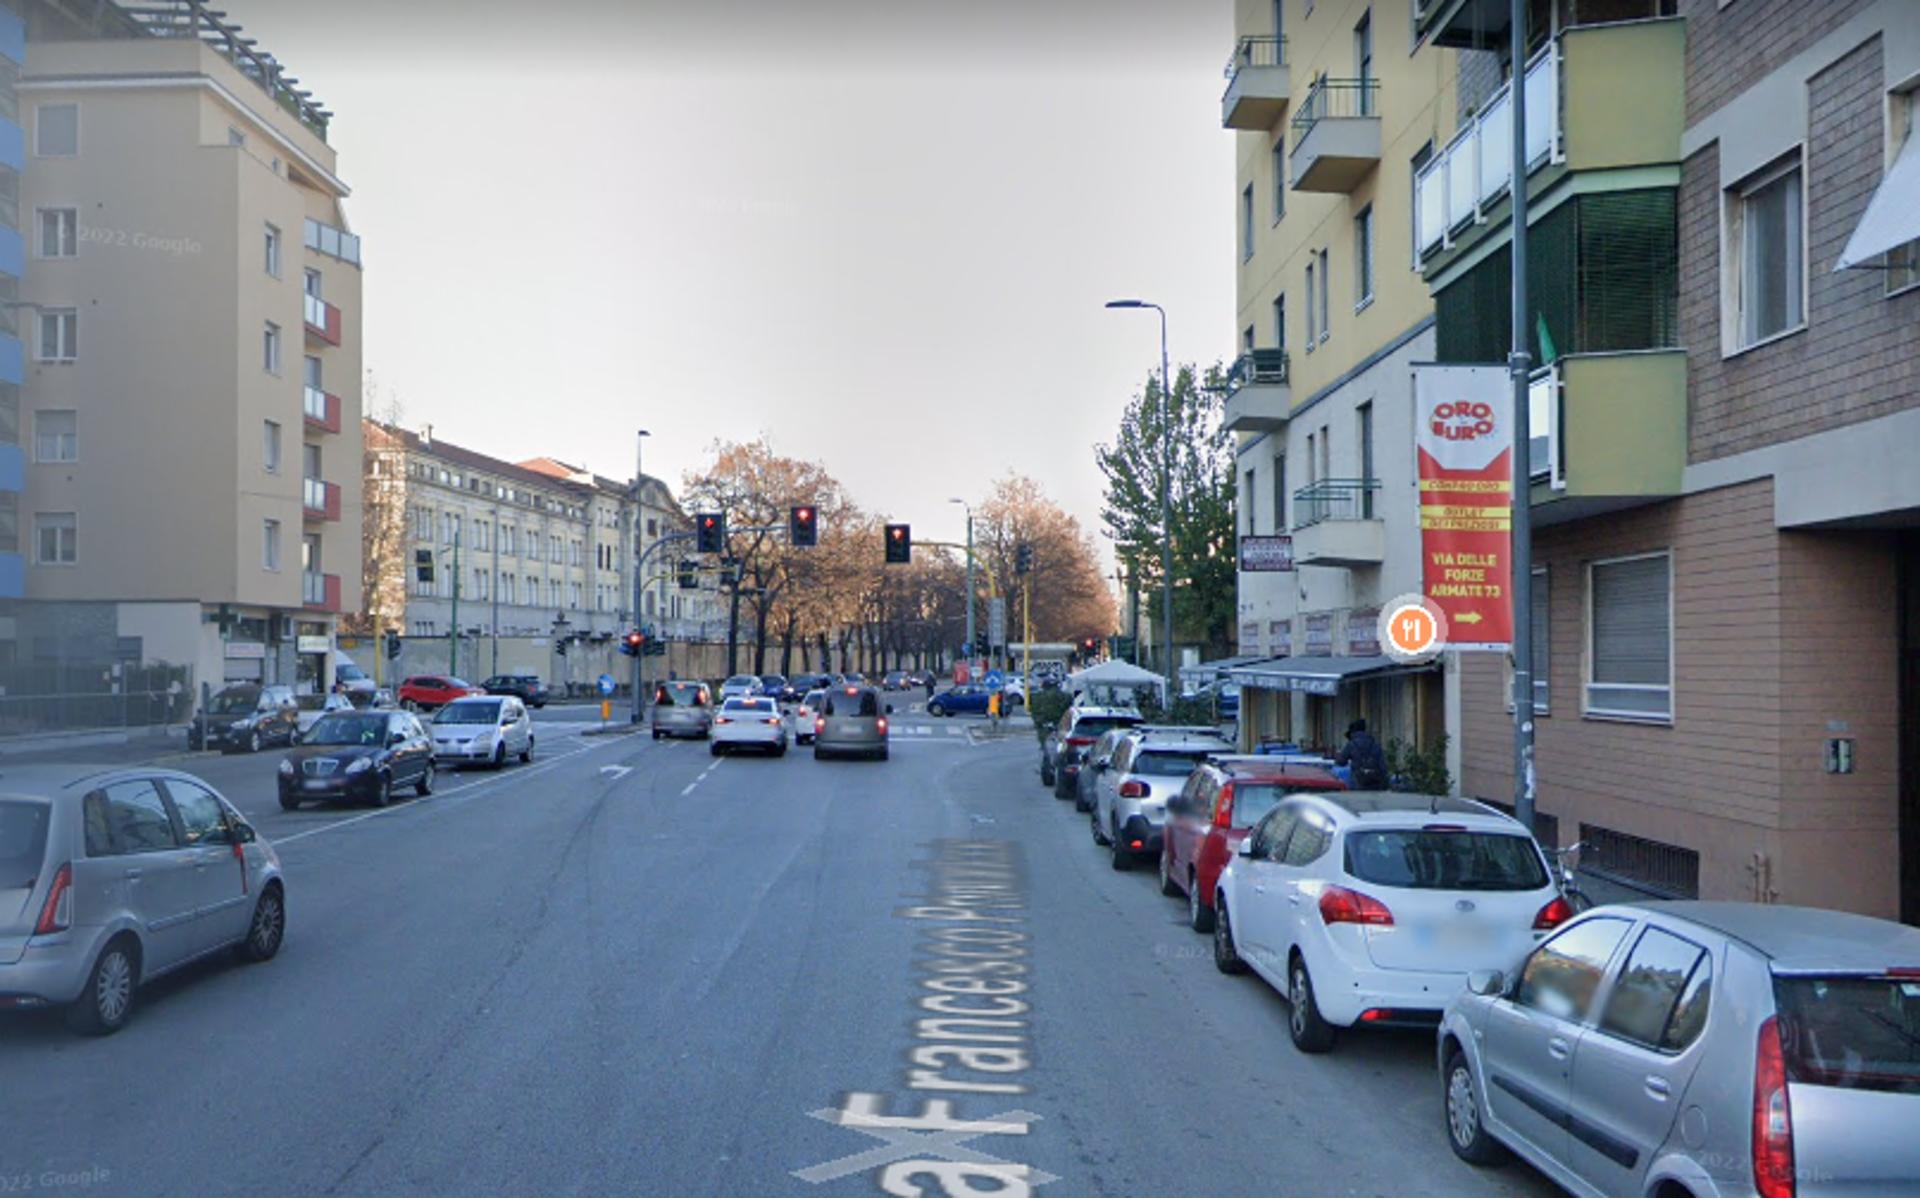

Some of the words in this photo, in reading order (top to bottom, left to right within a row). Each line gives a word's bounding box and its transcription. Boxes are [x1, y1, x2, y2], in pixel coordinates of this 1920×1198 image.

[1433, 401, 1492, 420] ORO
[1432, 420, 1494, 441] EURO
[1432, 552, 1455, 566] VIA
[1457, 553, 1497, 567] DELLE
[1444, 569, 1485, 582] FORZE
[1431, 584, 1482, 597] ARMATE
